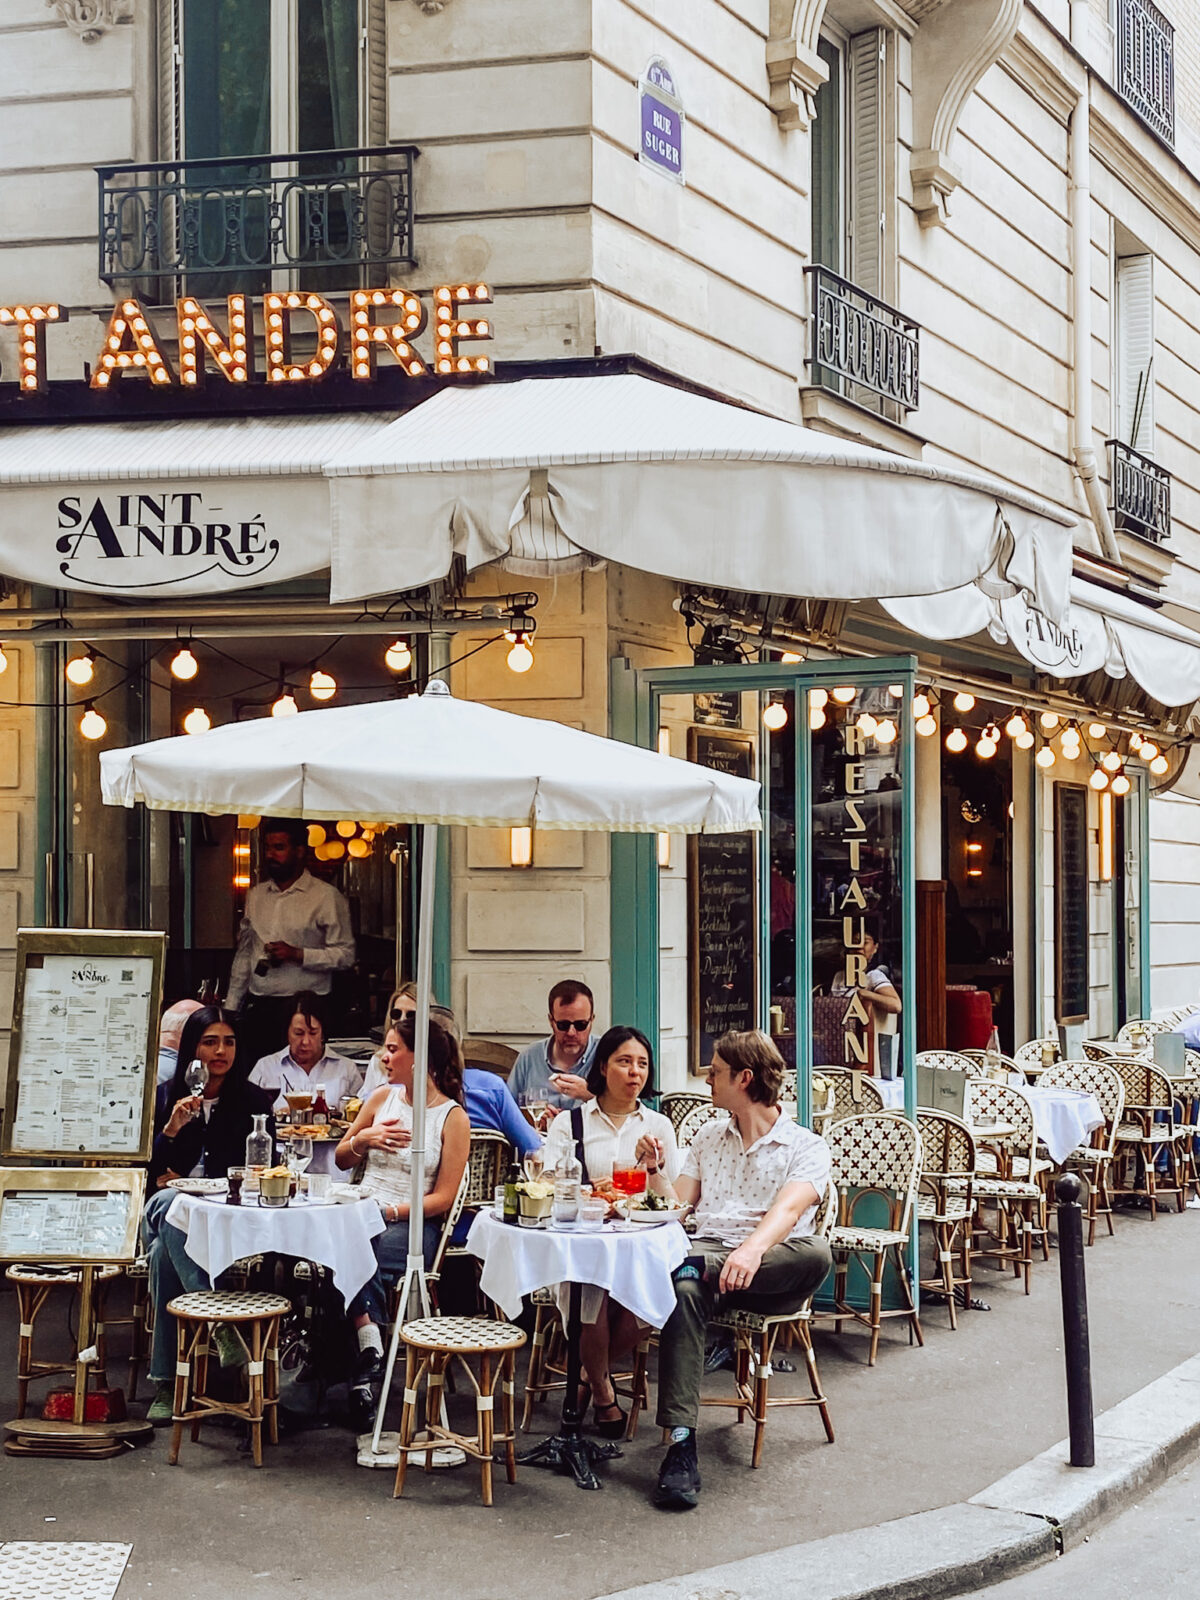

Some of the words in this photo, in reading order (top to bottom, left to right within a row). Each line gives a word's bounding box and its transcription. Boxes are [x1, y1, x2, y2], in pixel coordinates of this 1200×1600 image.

[645, 131, 680, 166] SUGER
[653, 110, 672, 136] RUE
[89, 283, 494, 389] ANDRE
[56, 510, 280, 566] ANDRÉ
[839, 725, 869, 1104] RESTAURANT
